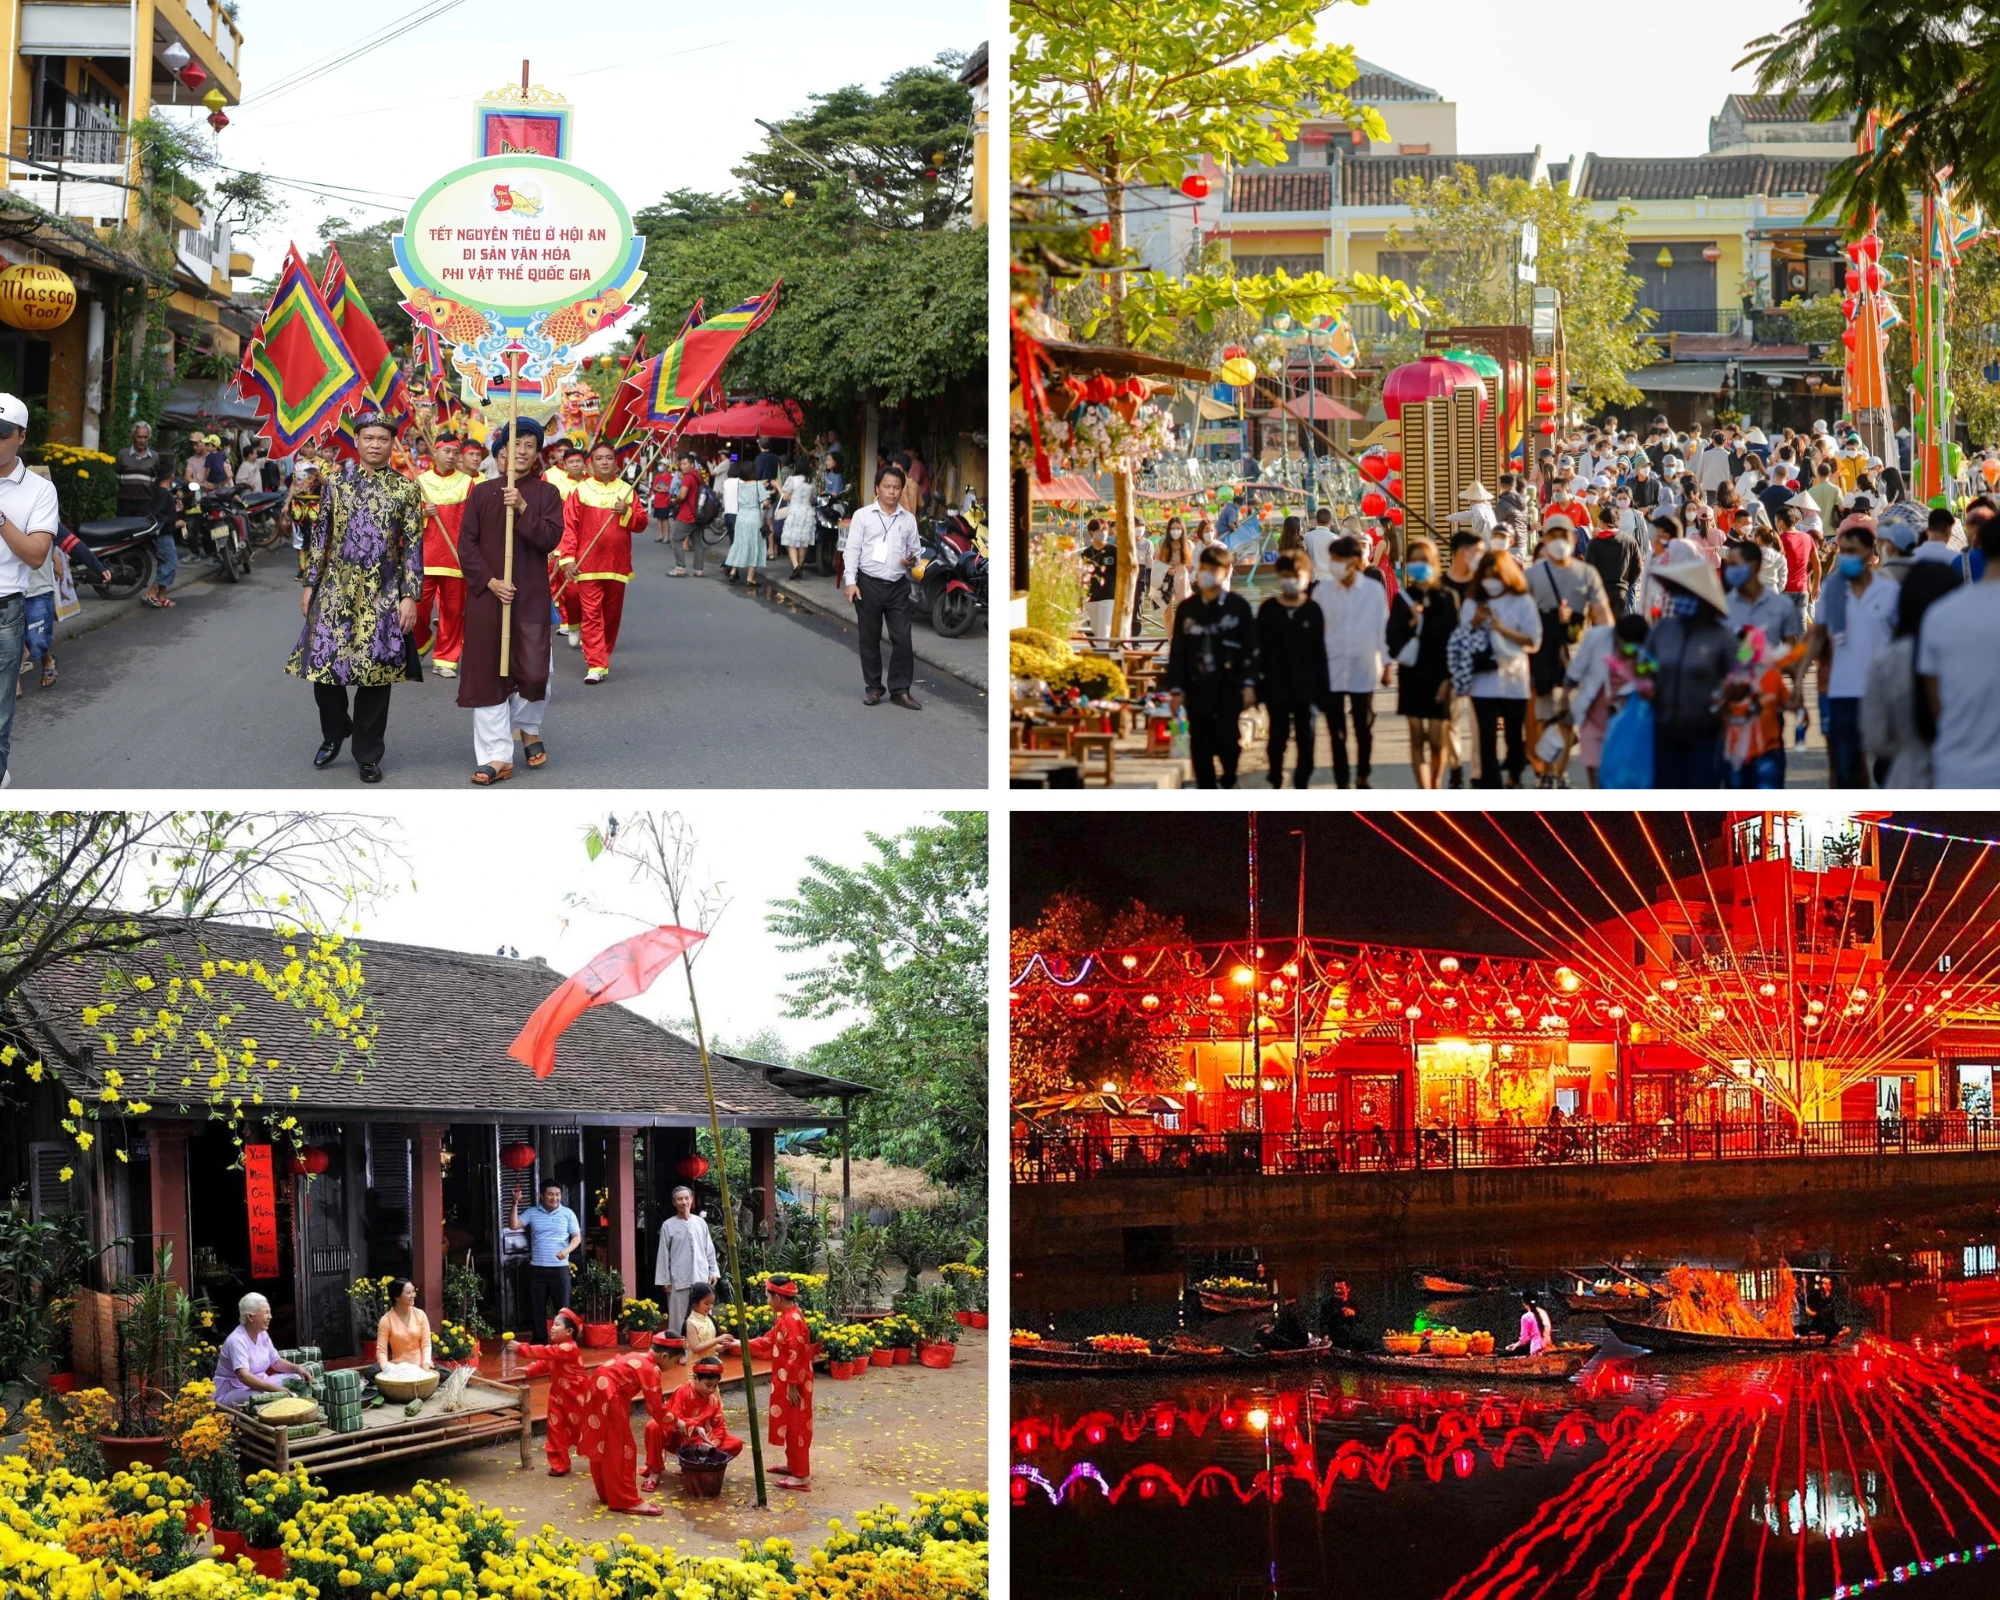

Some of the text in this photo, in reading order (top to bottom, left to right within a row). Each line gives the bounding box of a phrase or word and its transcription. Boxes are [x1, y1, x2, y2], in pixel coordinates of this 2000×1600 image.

[429, 225, 606, 244] TẾT NGUYÊN TIÊU Ở HỘI AN
[463, 245, 571, 260] DI SẢN VĂN HÓA
[442, 263, 591, 283] PHI VẬT THỂ QUỐC GIA
[23, 303, 62, 319] Foot
